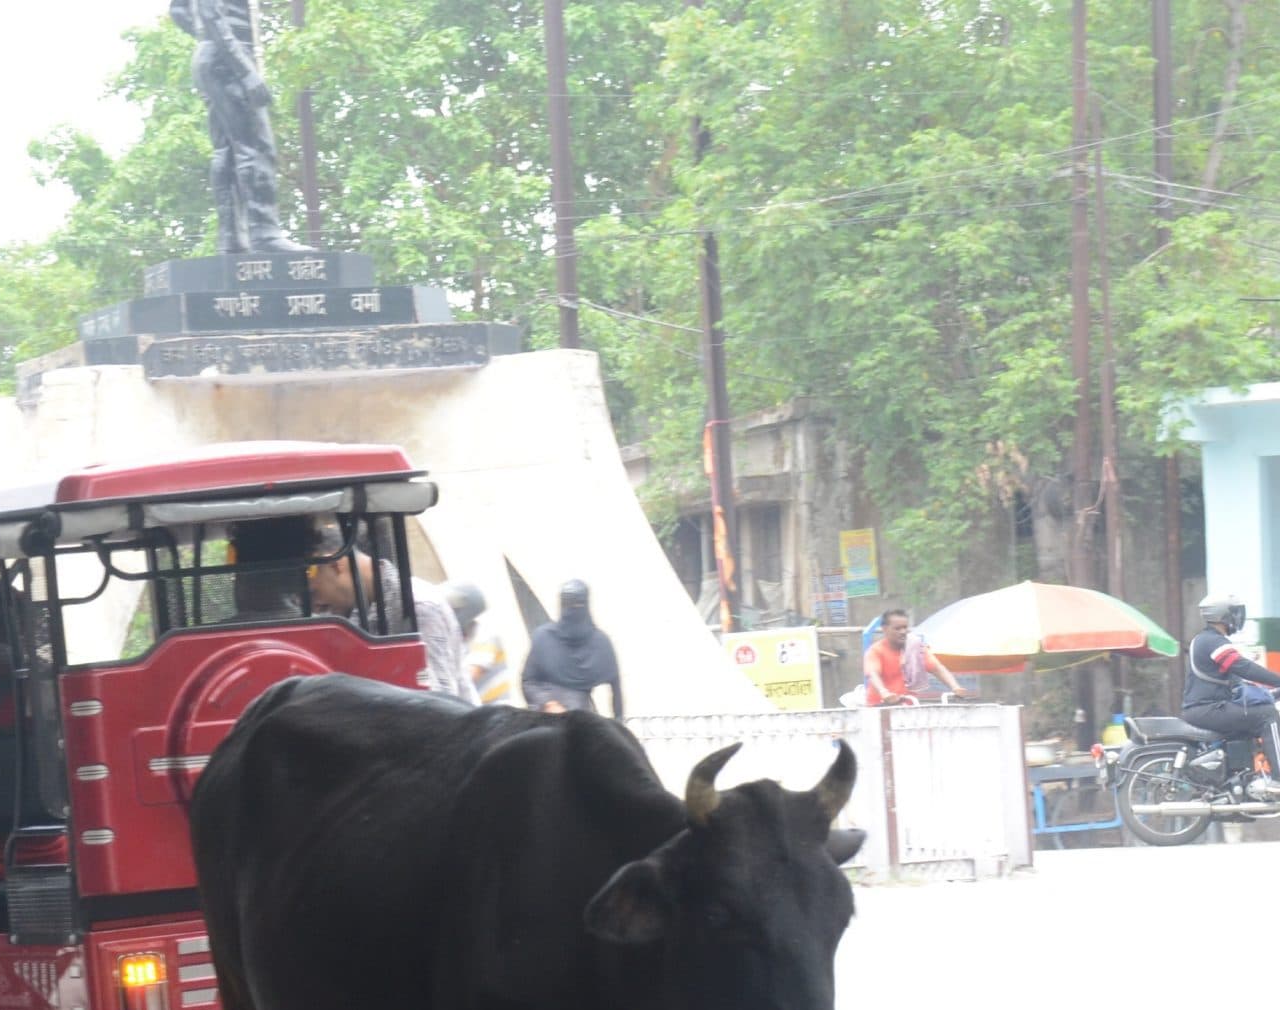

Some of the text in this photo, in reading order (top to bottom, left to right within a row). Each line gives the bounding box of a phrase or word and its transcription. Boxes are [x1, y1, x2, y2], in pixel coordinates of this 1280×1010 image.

[236, 256, 327, 281] अमर शहीद
[213, 288, 381, 317] रणधीर प्रसाद वर्मा
